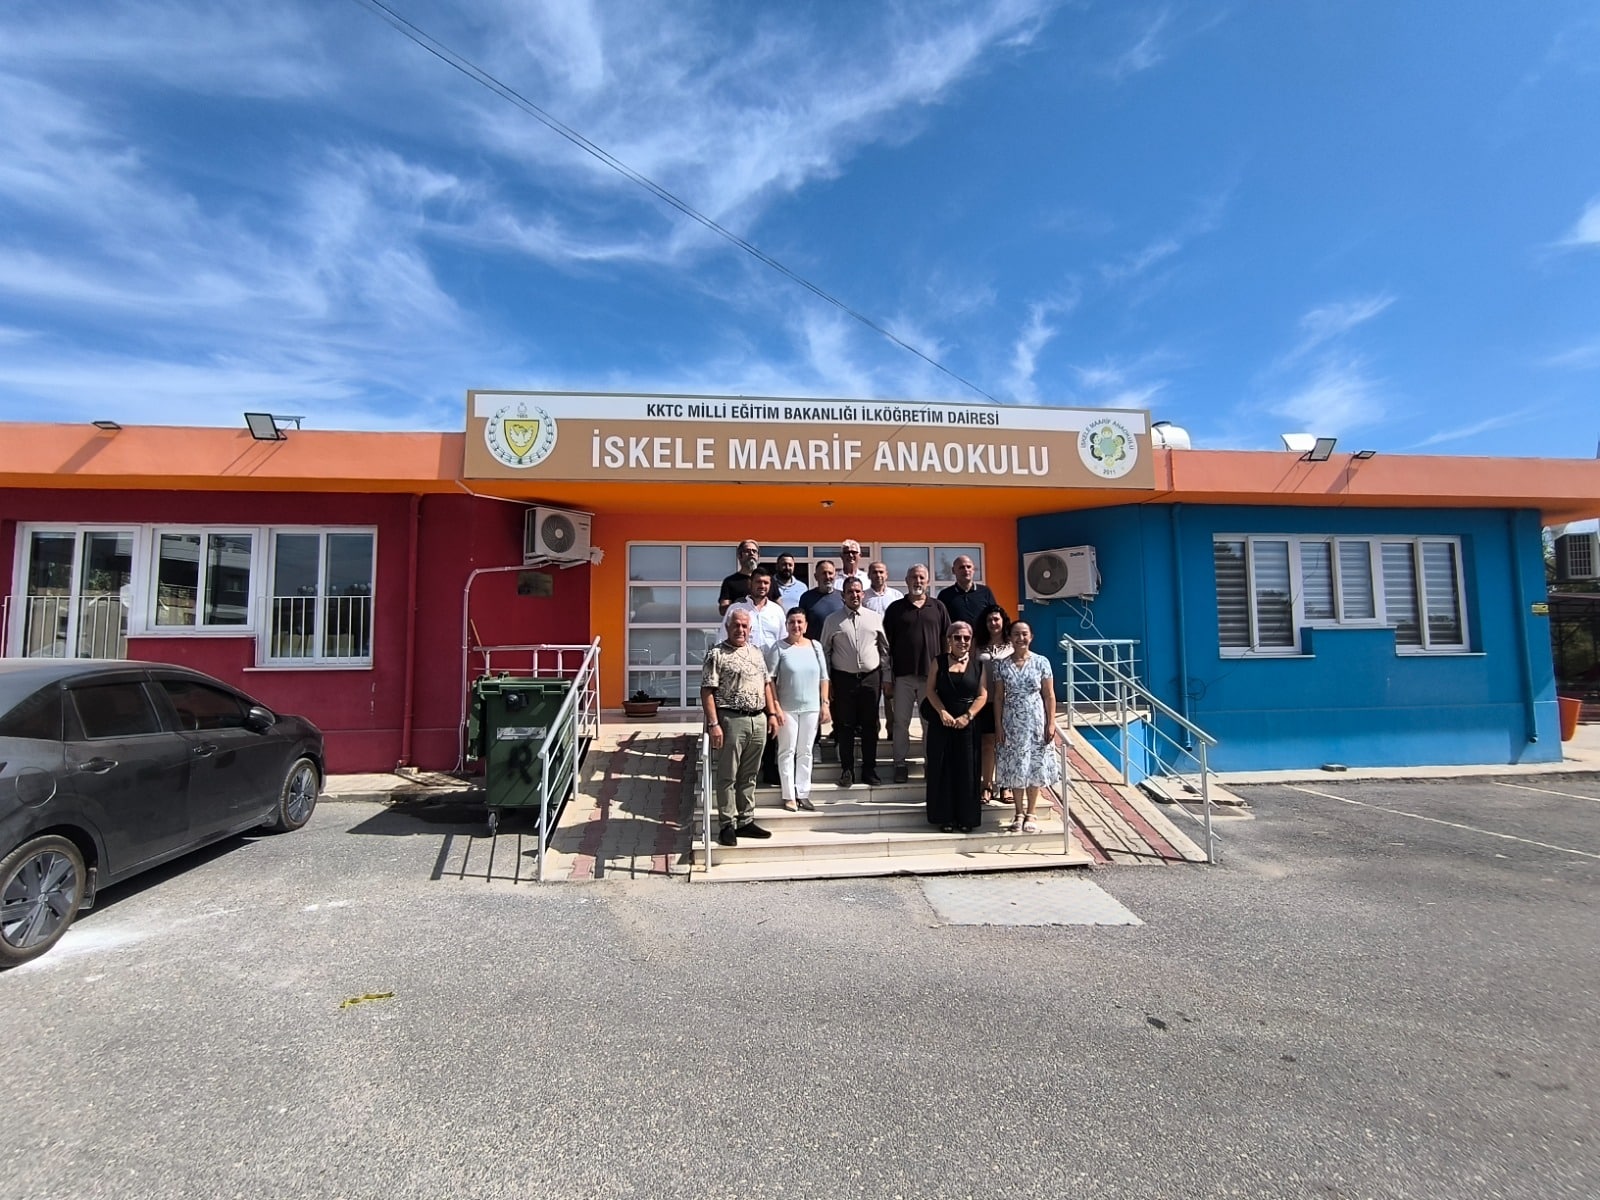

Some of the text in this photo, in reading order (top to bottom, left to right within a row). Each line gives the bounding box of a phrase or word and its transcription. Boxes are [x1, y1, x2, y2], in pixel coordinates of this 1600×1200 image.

[647, 402, 1000, 425] KKTC MİLLİ EĞİTİM BAKANLIĞI İLKÖĞRETİM DAİRESİ
[592, 429, 1049, 476] İSKELE MAARİF ANAOKULU
